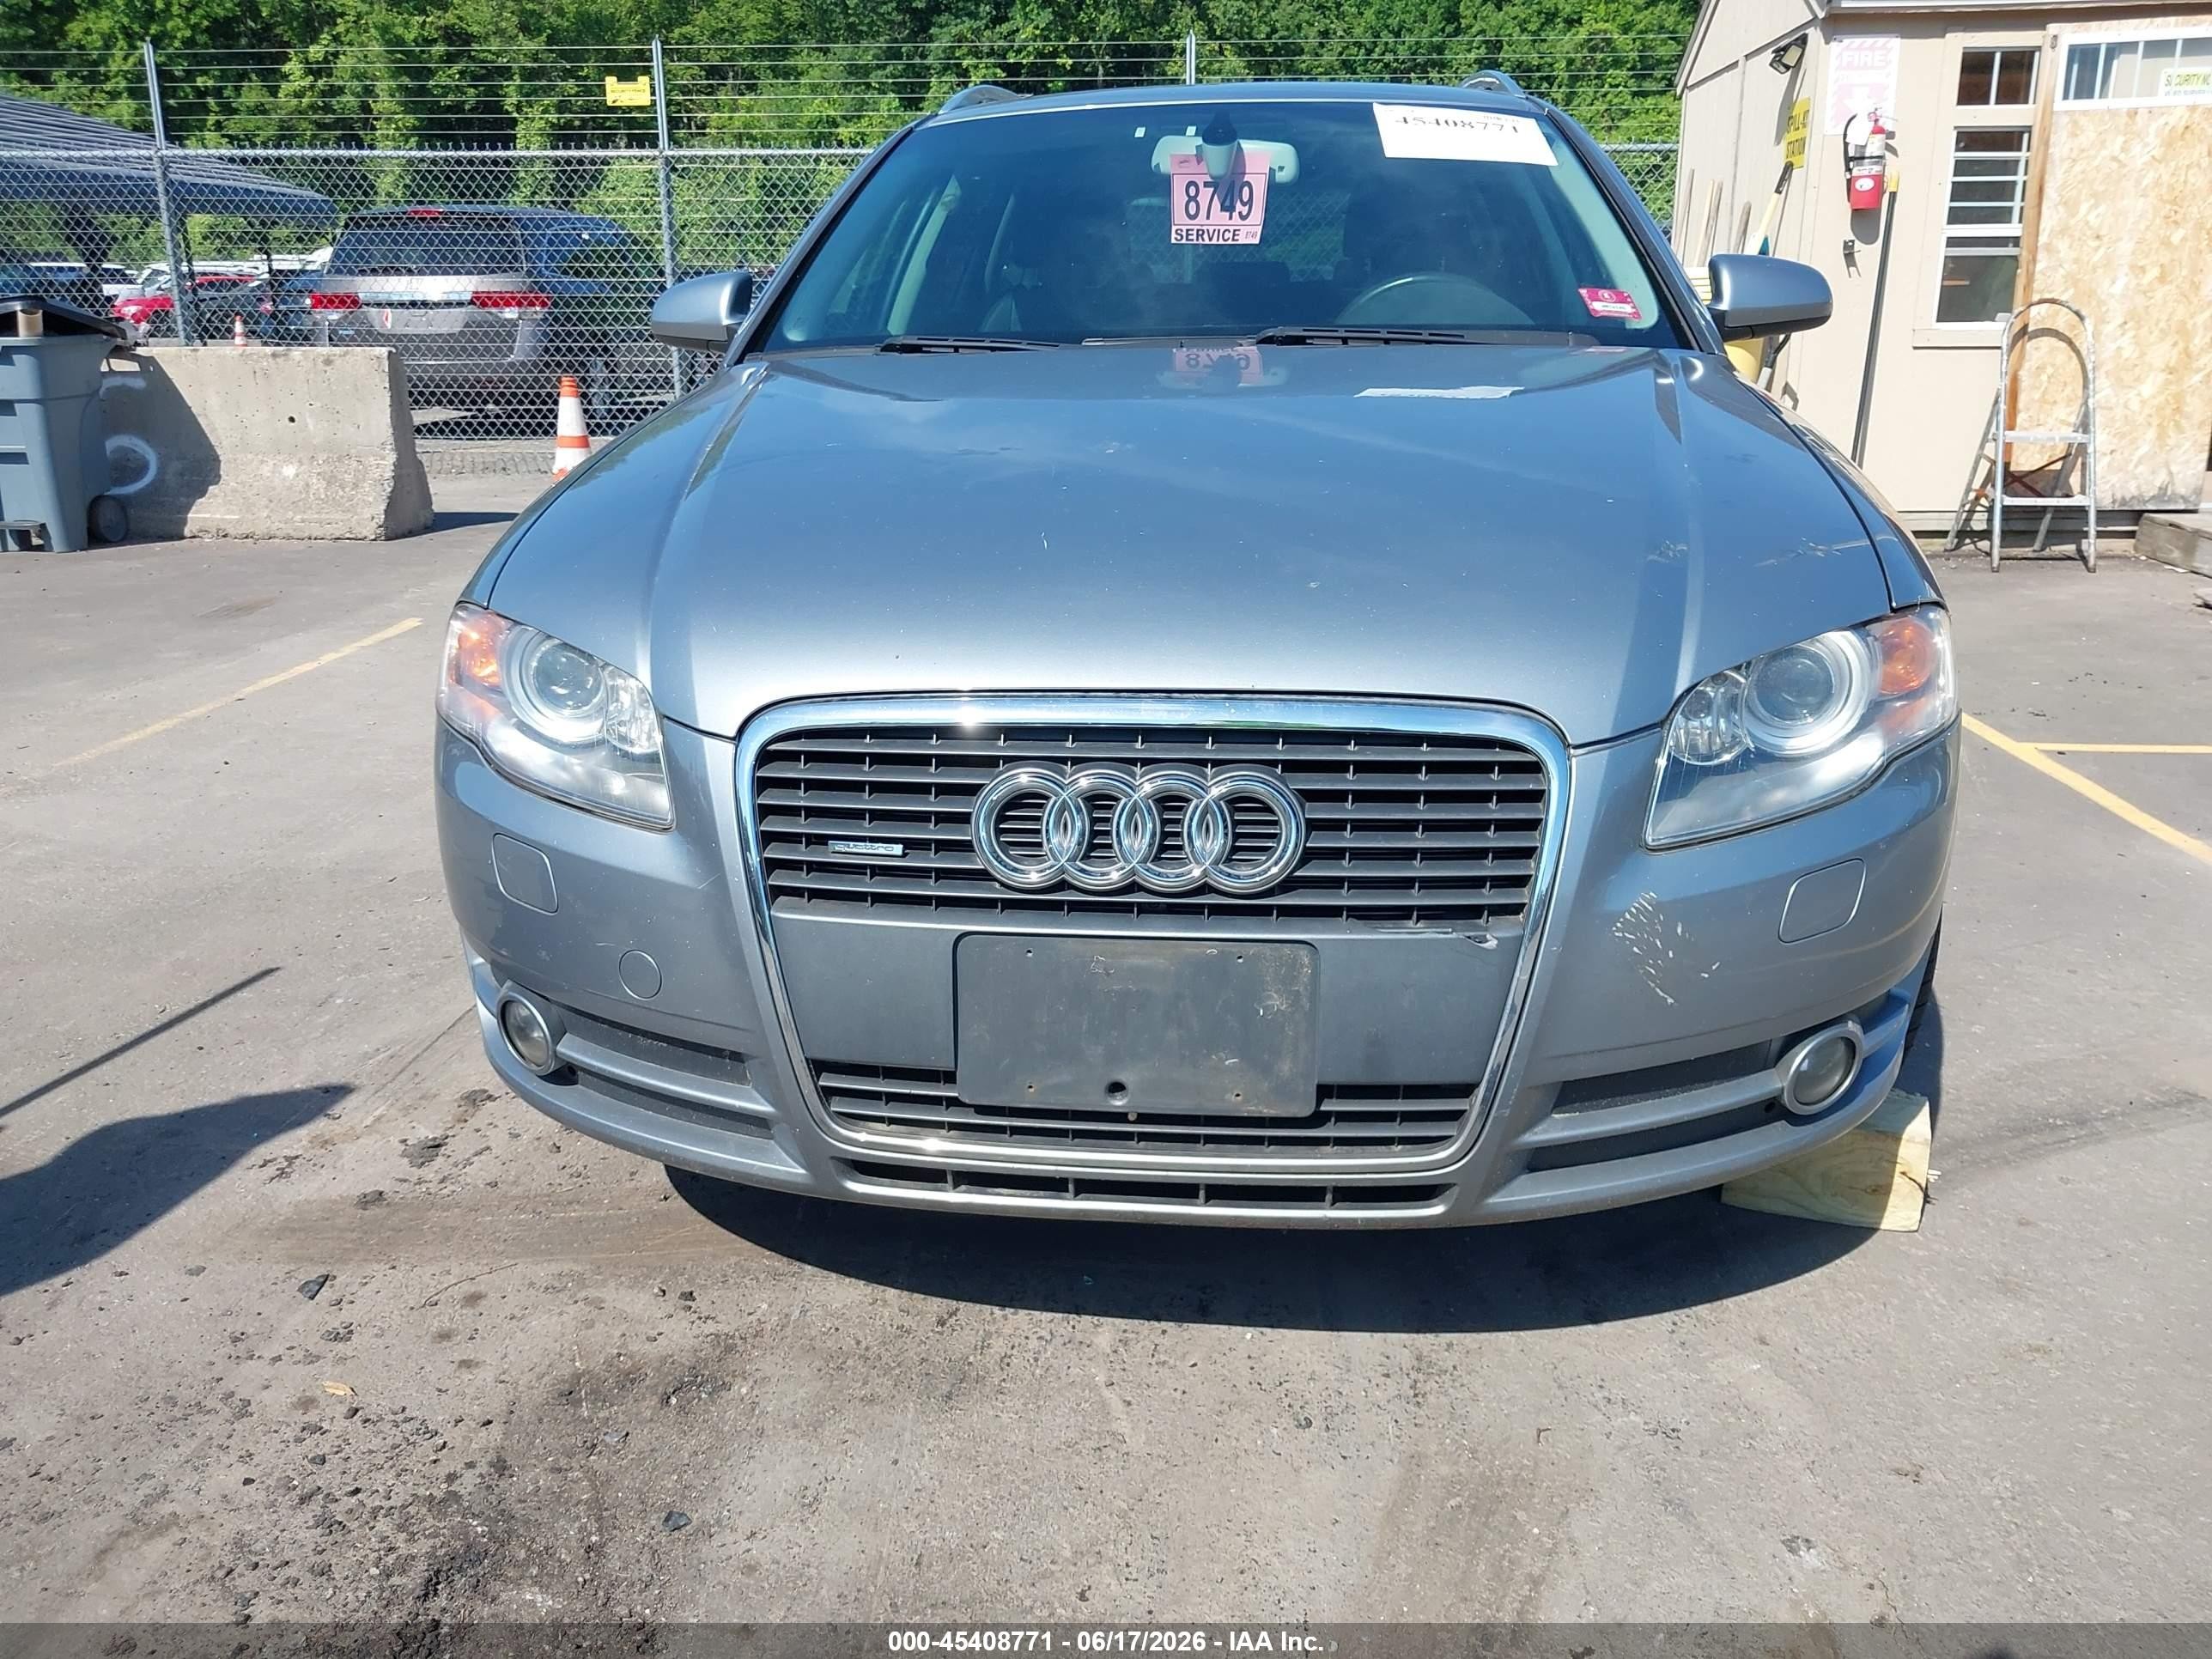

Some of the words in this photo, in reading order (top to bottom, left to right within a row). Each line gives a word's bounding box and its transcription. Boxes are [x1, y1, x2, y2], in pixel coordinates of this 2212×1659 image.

[1841, 51, 1887, 68] FIRE
[1786, 137, 1807, 159] STATION
[1184, 179, 1254, 221] 8749
[1174, 228, 1241, 242] SERVICE
[834, 842, 895, 853] quattro
